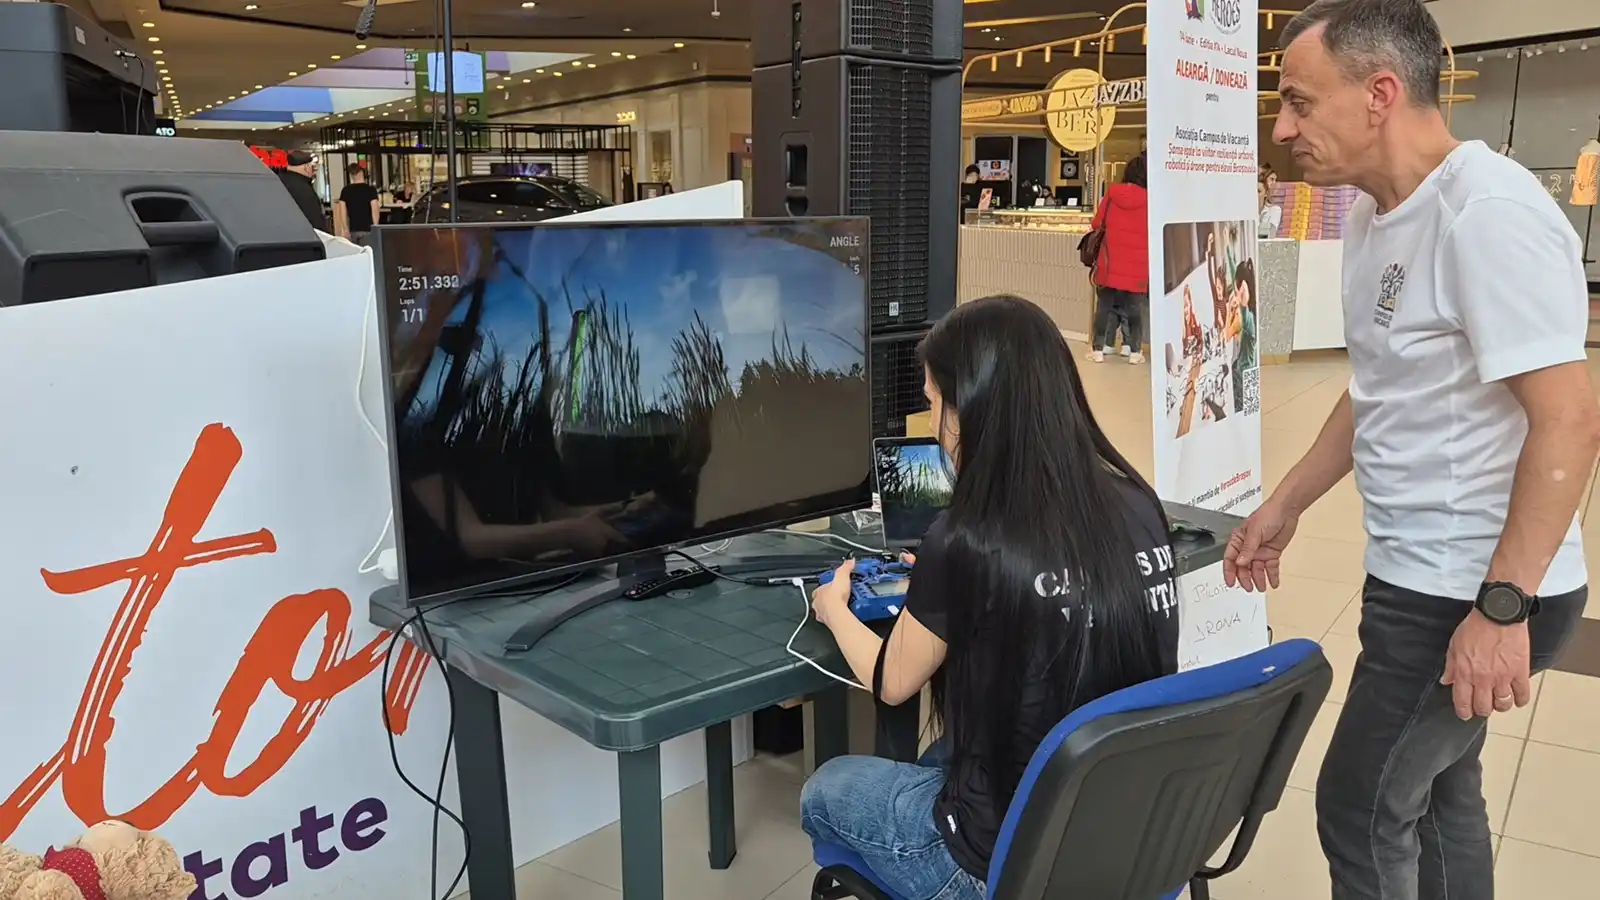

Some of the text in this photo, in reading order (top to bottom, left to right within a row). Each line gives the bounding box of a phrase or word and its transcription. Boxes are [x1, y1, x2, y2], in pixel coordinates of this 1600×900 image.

[1176, 59, 1209, 82] ALEARGĂ
[1215, 69, 1248, 90] DONEAZĂ
[1200, 129, 1220, 145] Campus
[1221, 132, 1226, 144] de
[830, 236, 860, 247] ANGLE
[401, 308, 423, 323] 1/1
